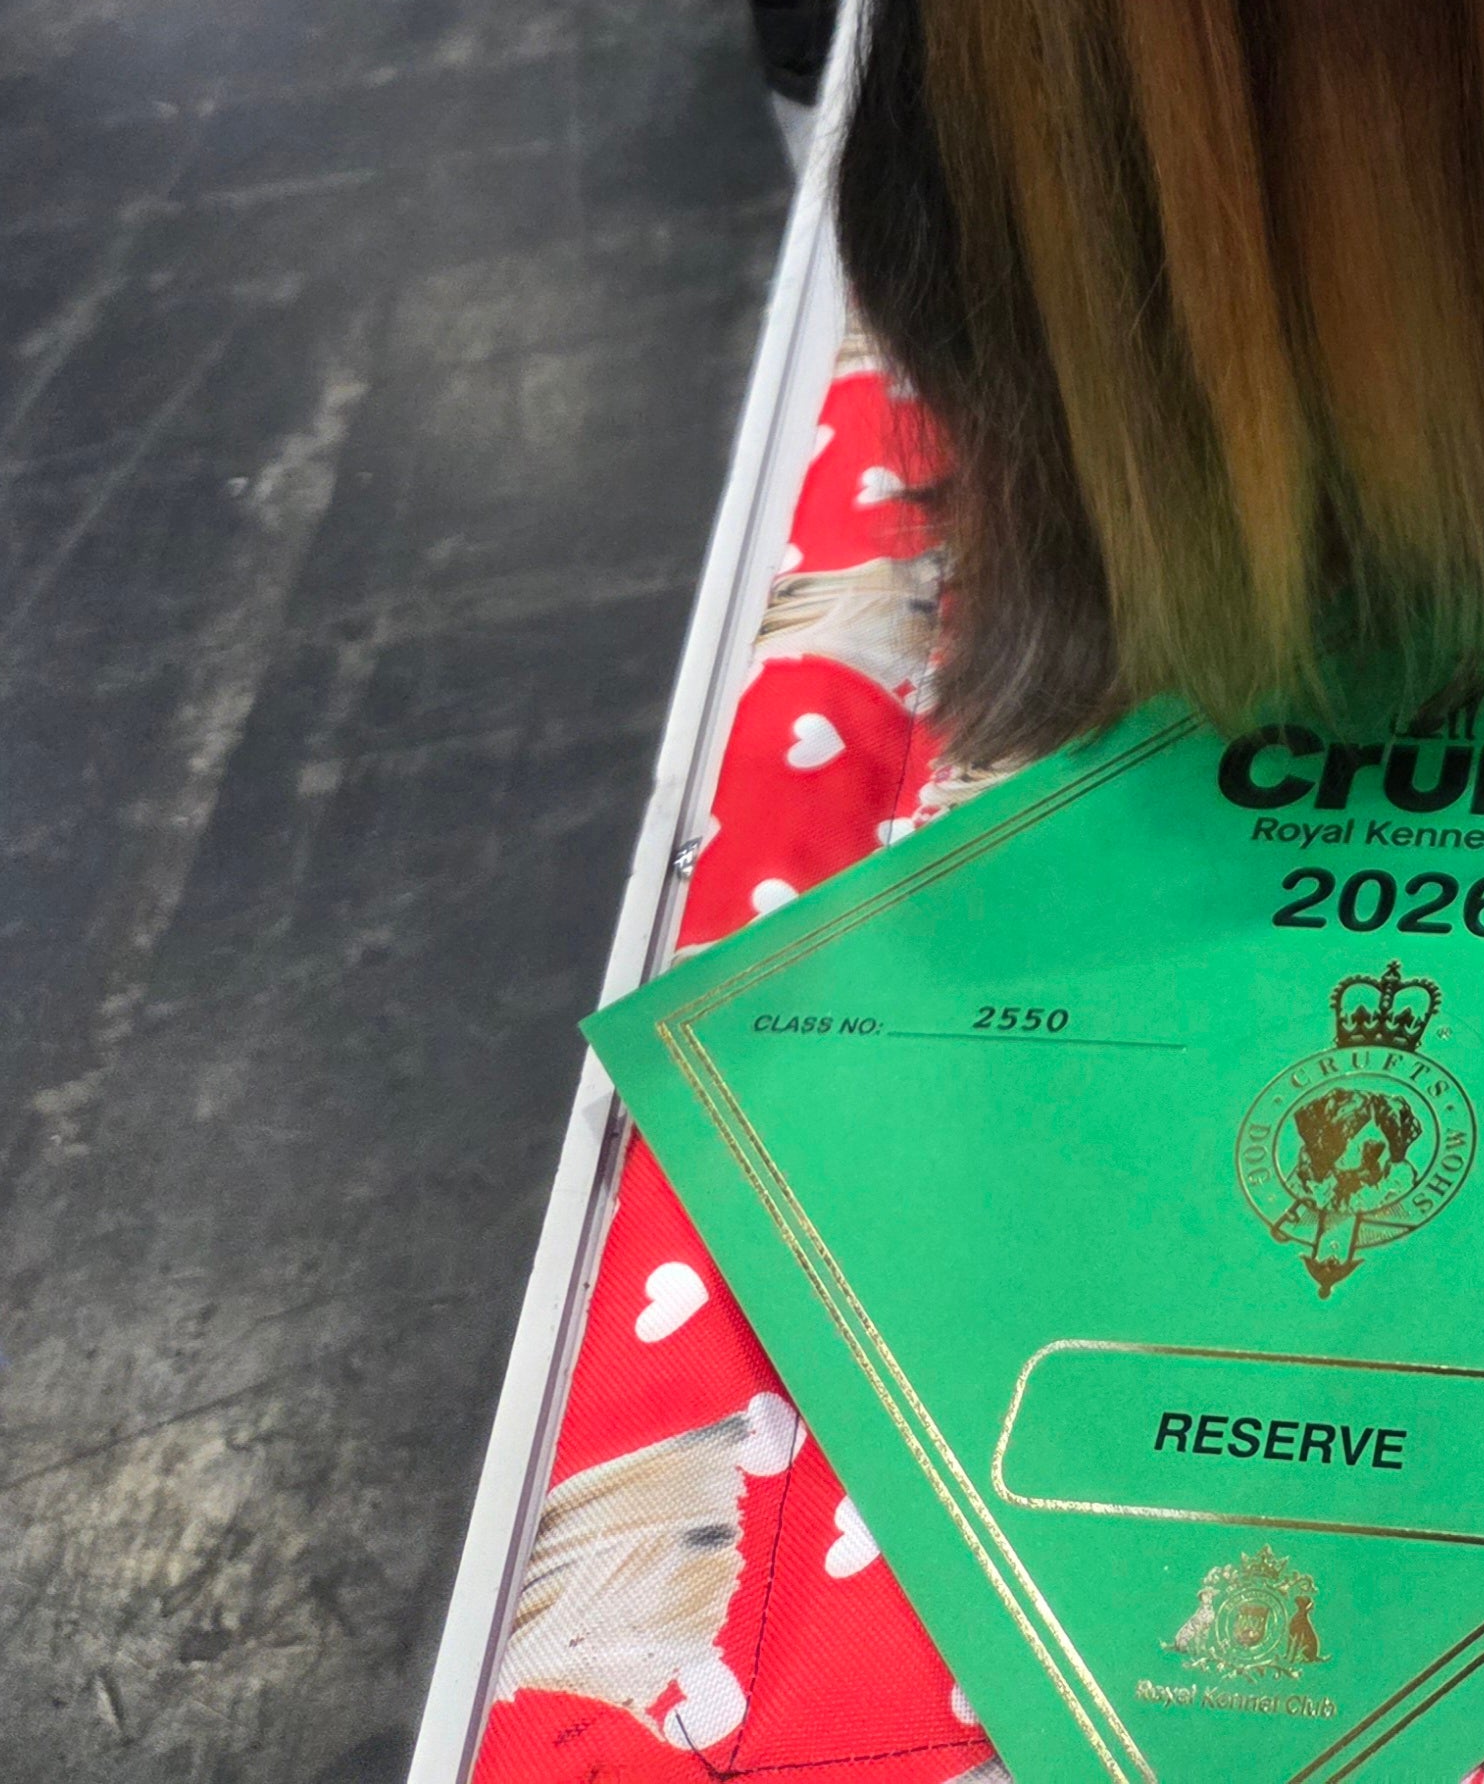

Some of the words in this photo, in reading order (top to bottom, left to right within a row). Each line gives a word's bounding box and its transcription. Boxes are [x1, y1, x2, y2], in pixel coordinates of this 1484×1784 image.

[1251, 817, 1354, 850] Royal
[753, 1014, 831, 1034] CLASS
[838, 1018, 881, 1036] NO:
[972, 1006, 1069, 1033] 2550
[1290, 1050, 1450, 1098] CRUFTS
[1412, 1127, 1467, 1215] SHOW
[1154, 1412, 1407, 1470] RESERVE
